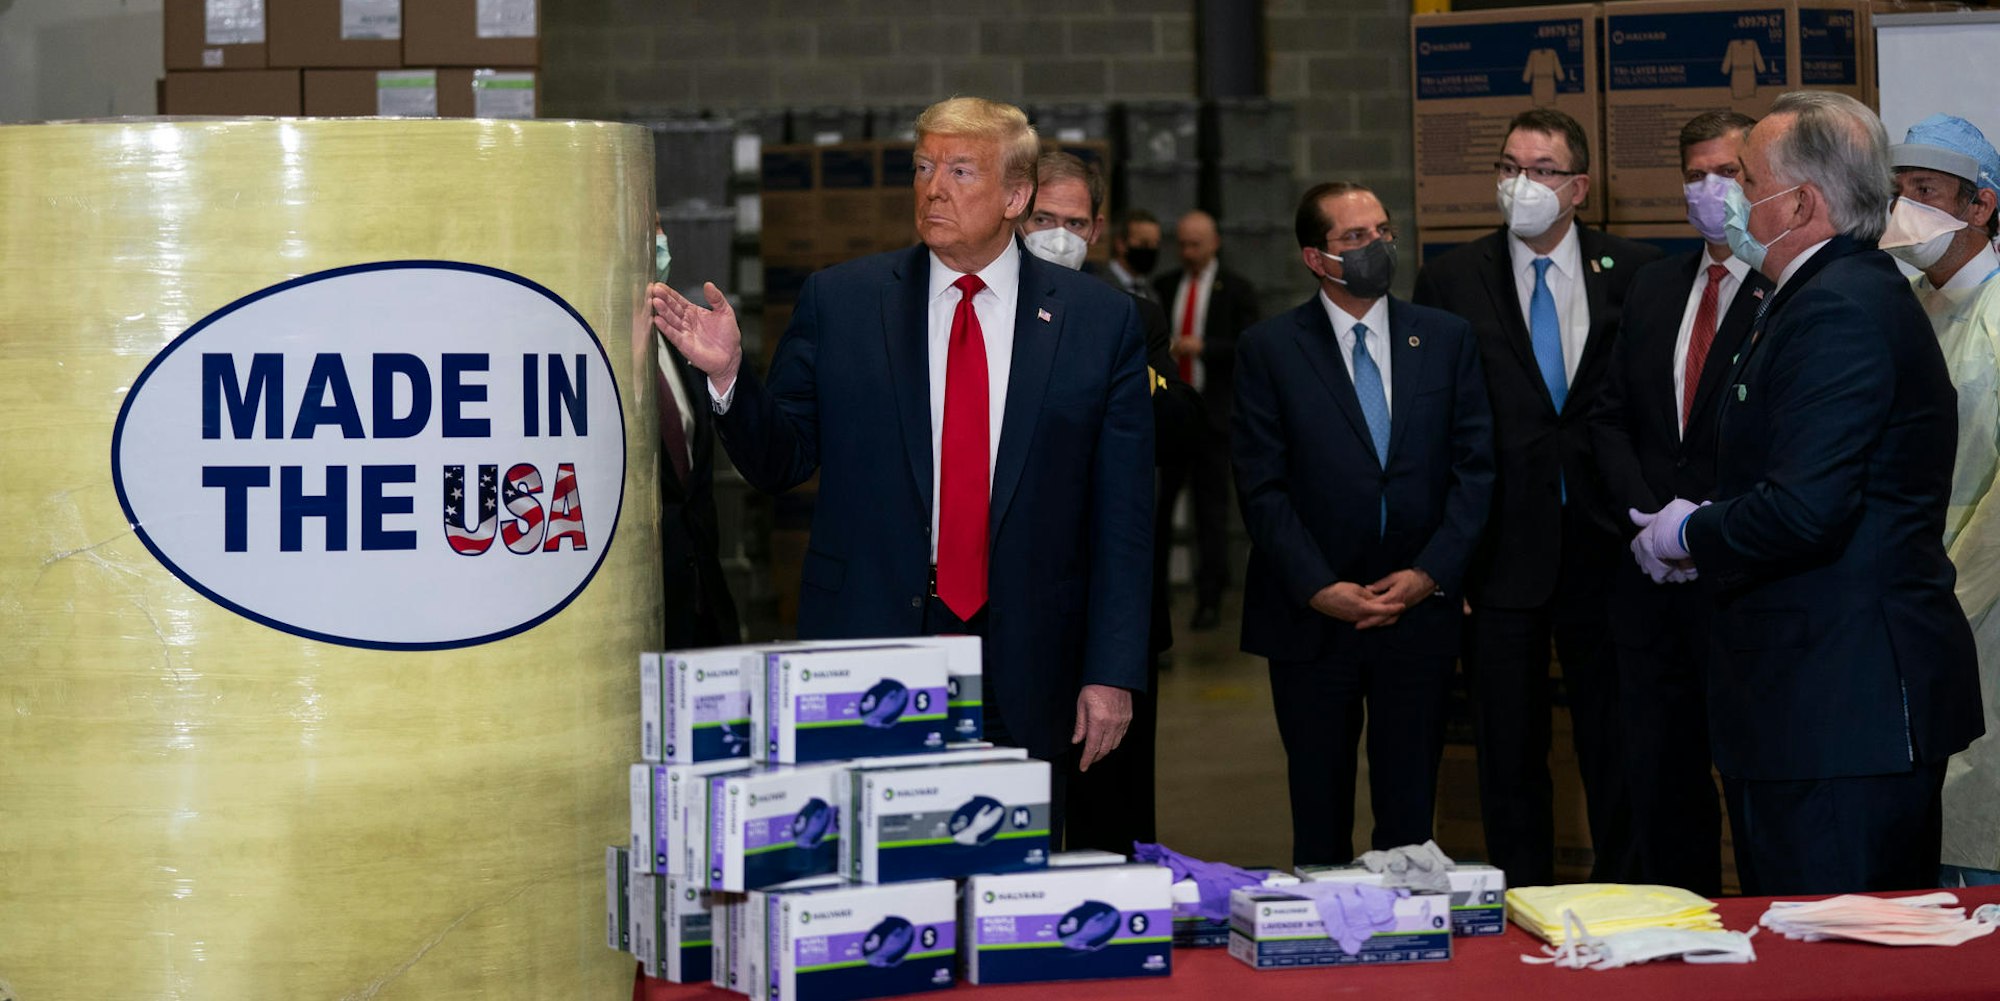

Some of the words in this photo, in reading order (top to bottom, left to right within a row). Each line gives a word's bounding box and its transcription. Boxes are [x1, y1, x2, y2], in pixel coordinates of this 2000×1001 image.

[1624, 30, 1667, 42] HALYARD
[1770, 60, 1779, 73] L
[1568, 69, 1578, 81] L
[202, 352, 491, 439] MADE
[523, 353, 588, 437] IN
[202, 464, 417, 553] THE
[443, 462, 588, 557] USA
[813, 670, 850, 679] HALYARD
[917, 693, 928, 710] S
[896, 788, 940, 797] HALYARD
[1014, 810, 1029, 826] M
[998, 891, 1045, 900] HALYARD
[813, 908, 852, 920] HALYARD
[1133, 915, 1145, 932] S
[1261, 921, 1304, 930] LAVENDER
[1435, 917, 1443, 927] L
[924, 929, 935, 947] S
